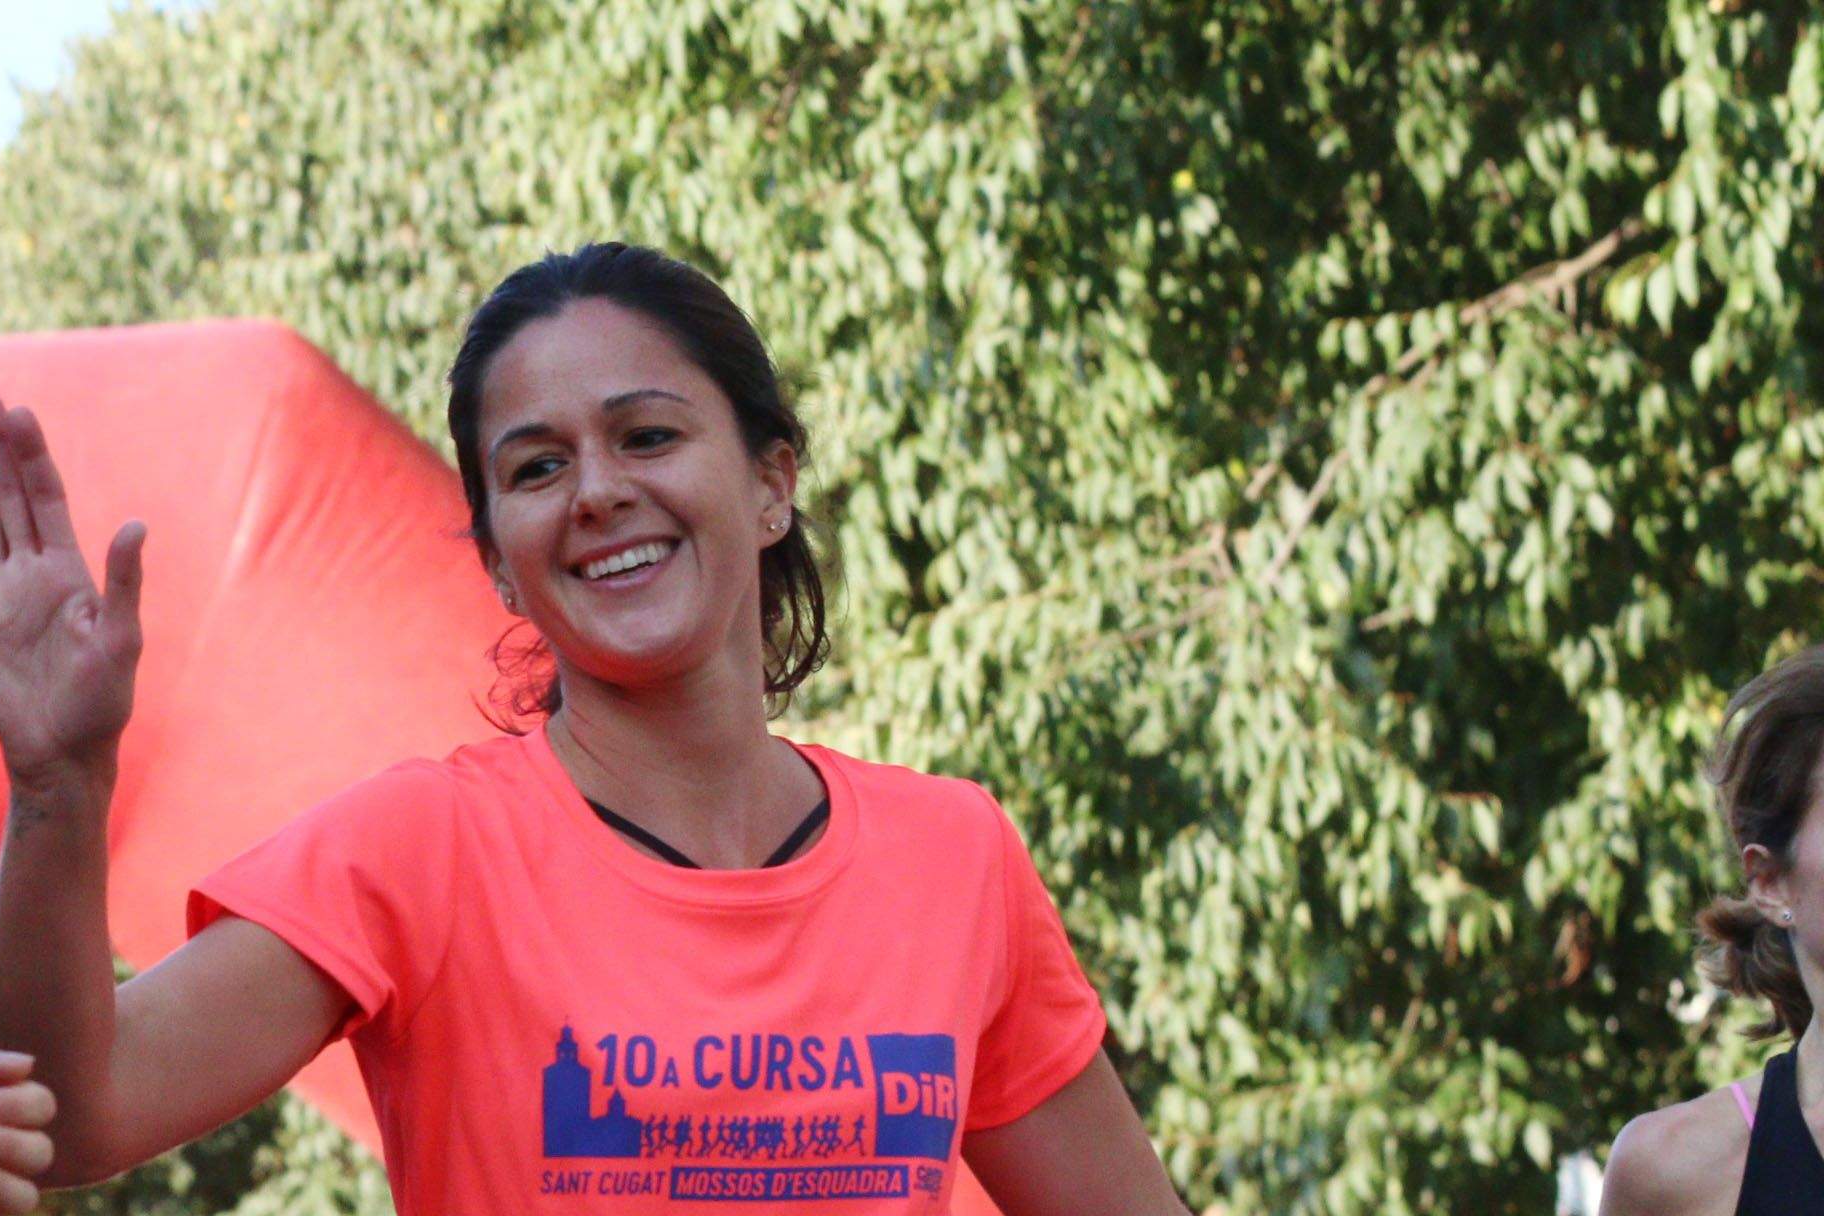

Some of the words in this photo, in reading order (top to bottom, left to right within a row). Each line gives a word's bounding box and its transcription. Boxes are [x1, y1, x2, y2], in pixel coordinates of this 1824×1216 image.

[692, 1034, 864, 1091] CURSA
[881, 1071, 957, 1121] DiR
[540, 1170, 593, 1195] SANT
[598, 1170, 666, 1195] CUGAT
[676, 1171, 767, 1197] MOSSOS
[770, 1168, 903, 1196] D'ESQUADRA
